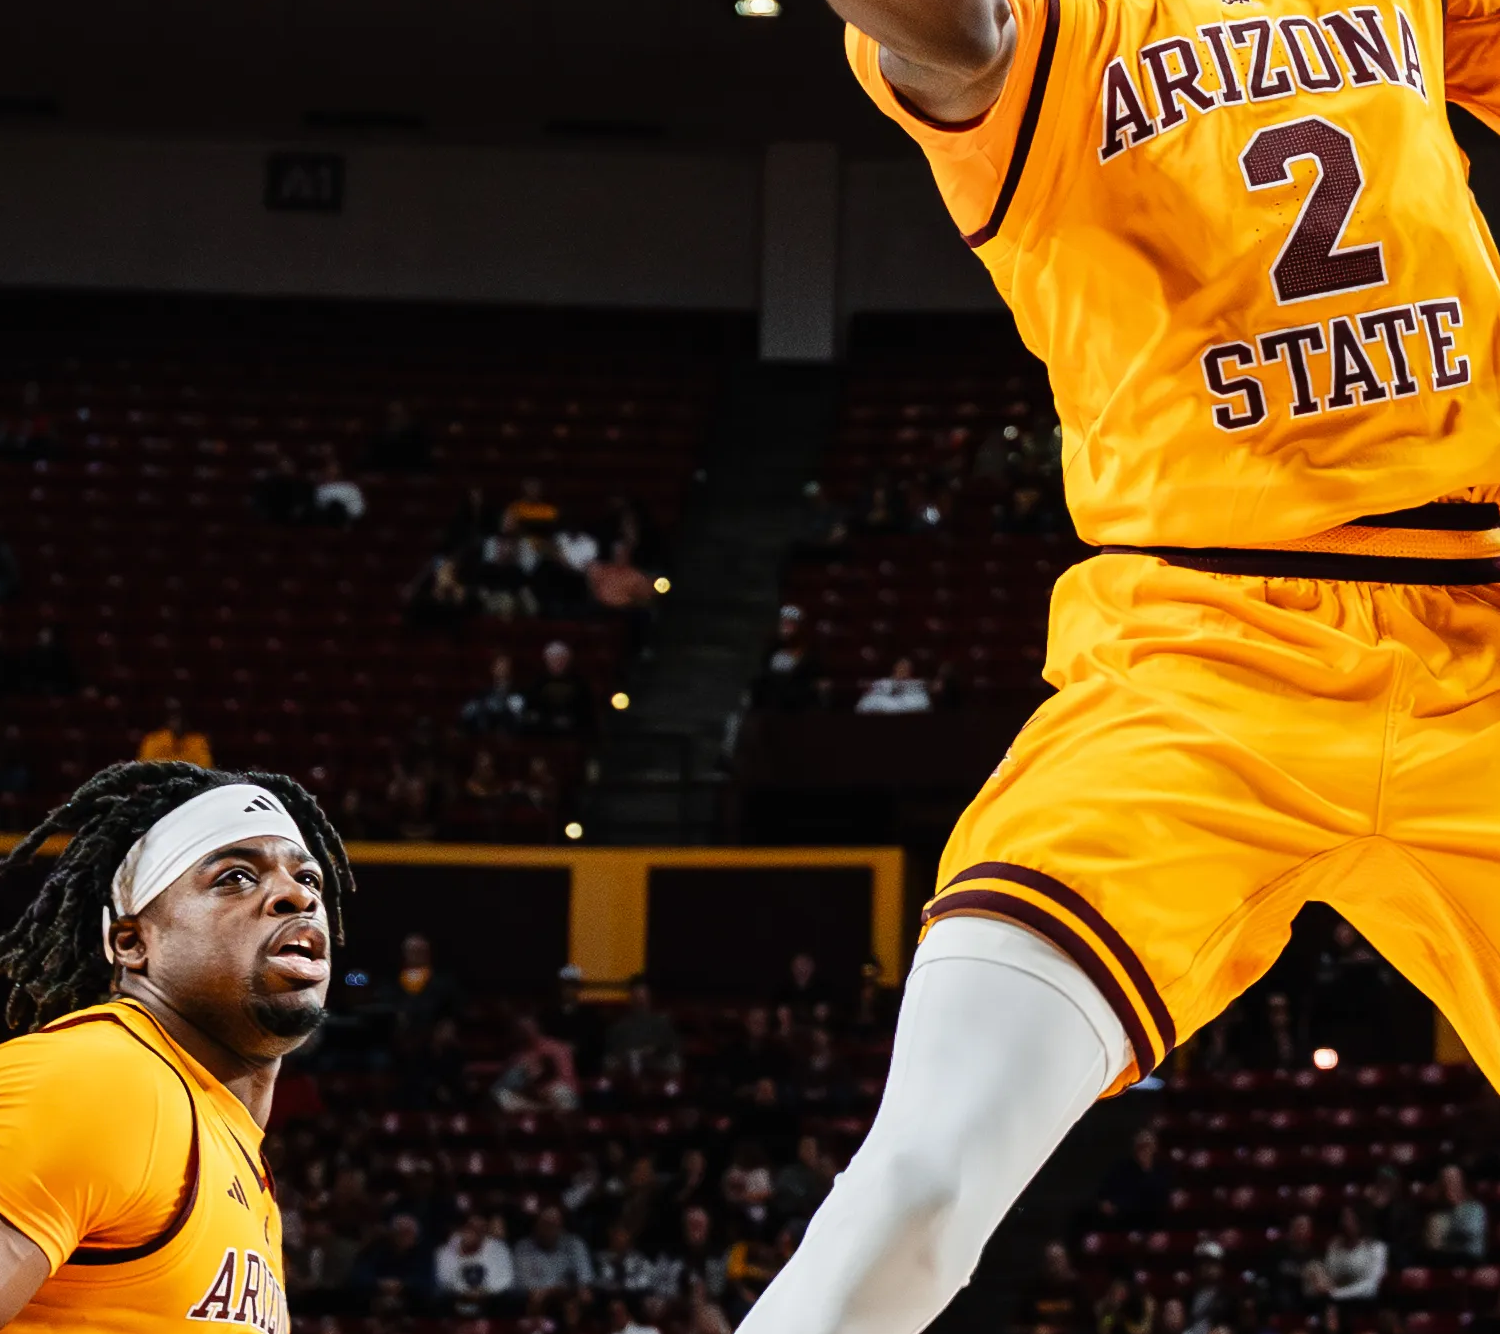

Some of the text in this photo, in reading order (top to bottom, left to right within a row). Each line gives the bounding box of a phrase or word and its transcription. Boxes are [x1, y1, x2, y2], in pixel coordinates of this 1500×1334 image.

[1097, 5, 1430, 164] ARIZONA
[1237, 114, 1389, 307] 2
[1201, 297, 1472, 433] STATE
